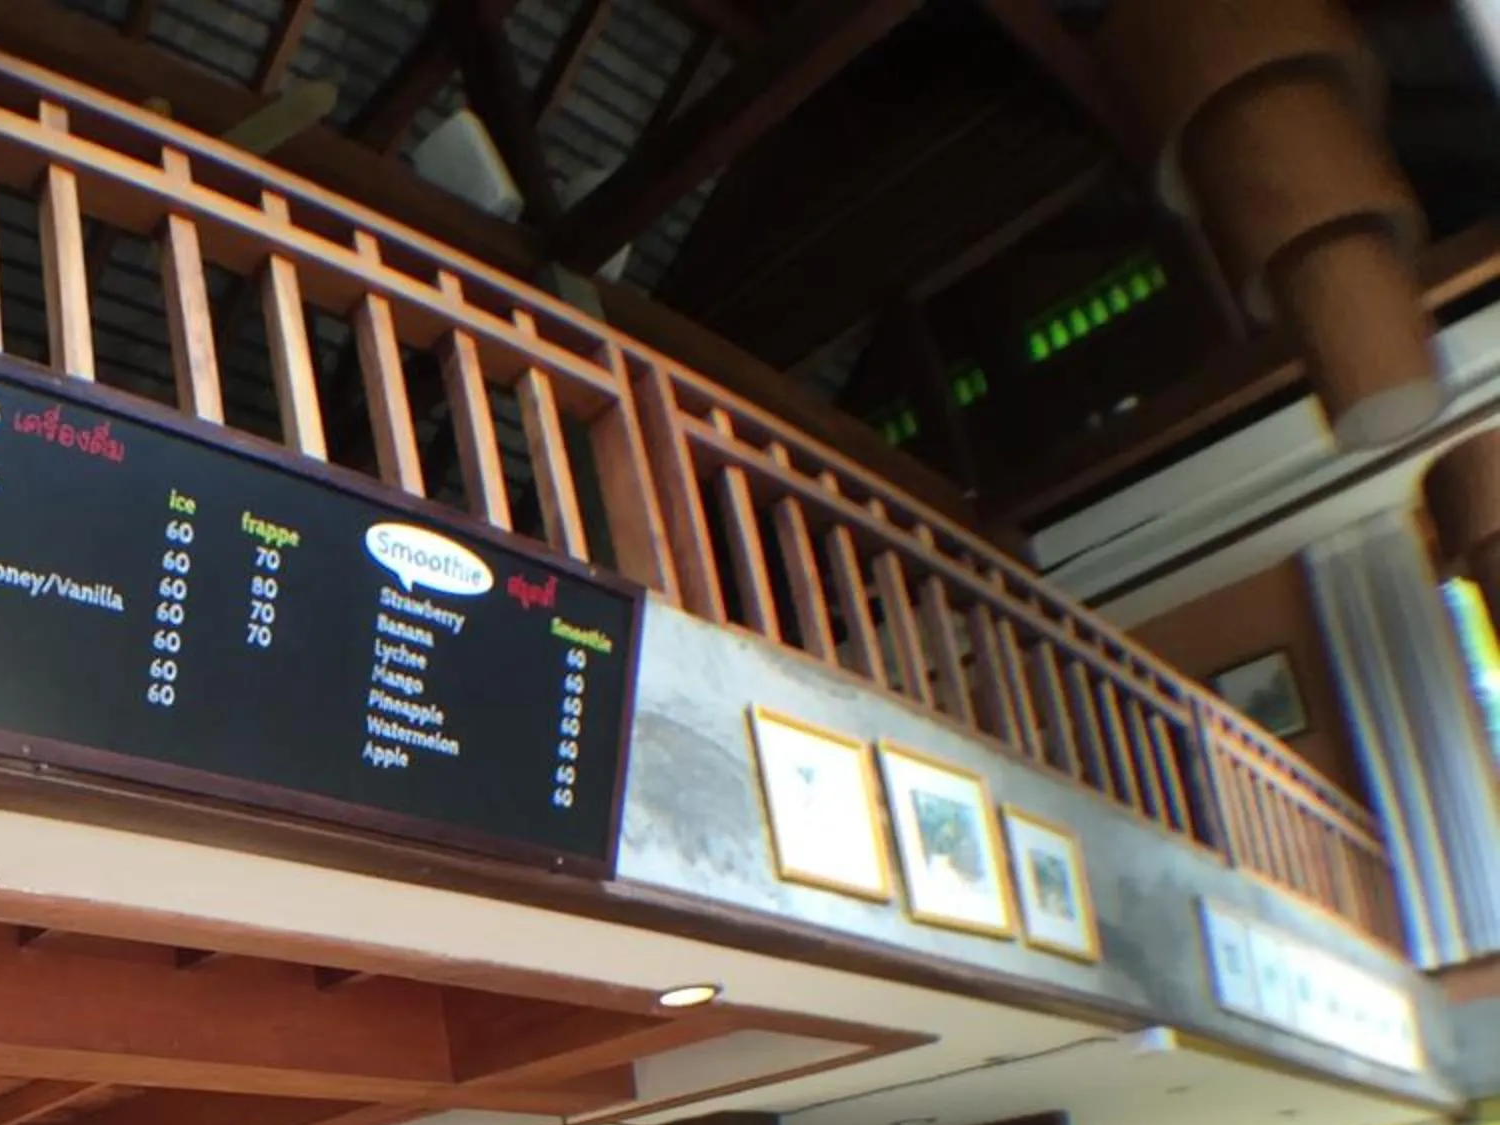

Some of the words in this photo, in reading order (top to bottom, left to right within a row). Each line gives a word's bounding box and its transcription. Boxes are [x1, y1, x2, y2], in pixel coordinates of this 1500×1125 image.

[169, 488, 197, 515] ice
[165, 520, 194, 544] 60
[241, 511, 300, 548] frappe
[162, 549, 190, 574] 60
[255, 546, 281, 571] 70
[377, 530, 482, 587] Smoothie
[159, 576, 188, 600] 60
[251, 575, 278, 600] 80
[156, 602, 184, 625] 60
[250, 600, 275, 624] 70
[380, 585, 466, 635] Strawberry
[153, 629, 181, 653] 60
[247, 623, 272, 647] 70
[150, 658, 178, 681] 60
[372, 663, 424, 695] Mango
[147, 683, 175, 706] 60
[368, 687, 444, 726] Pineapple
[366, 714, 459, 756] Watermelon
[362, 740, 409, 769] Apple
